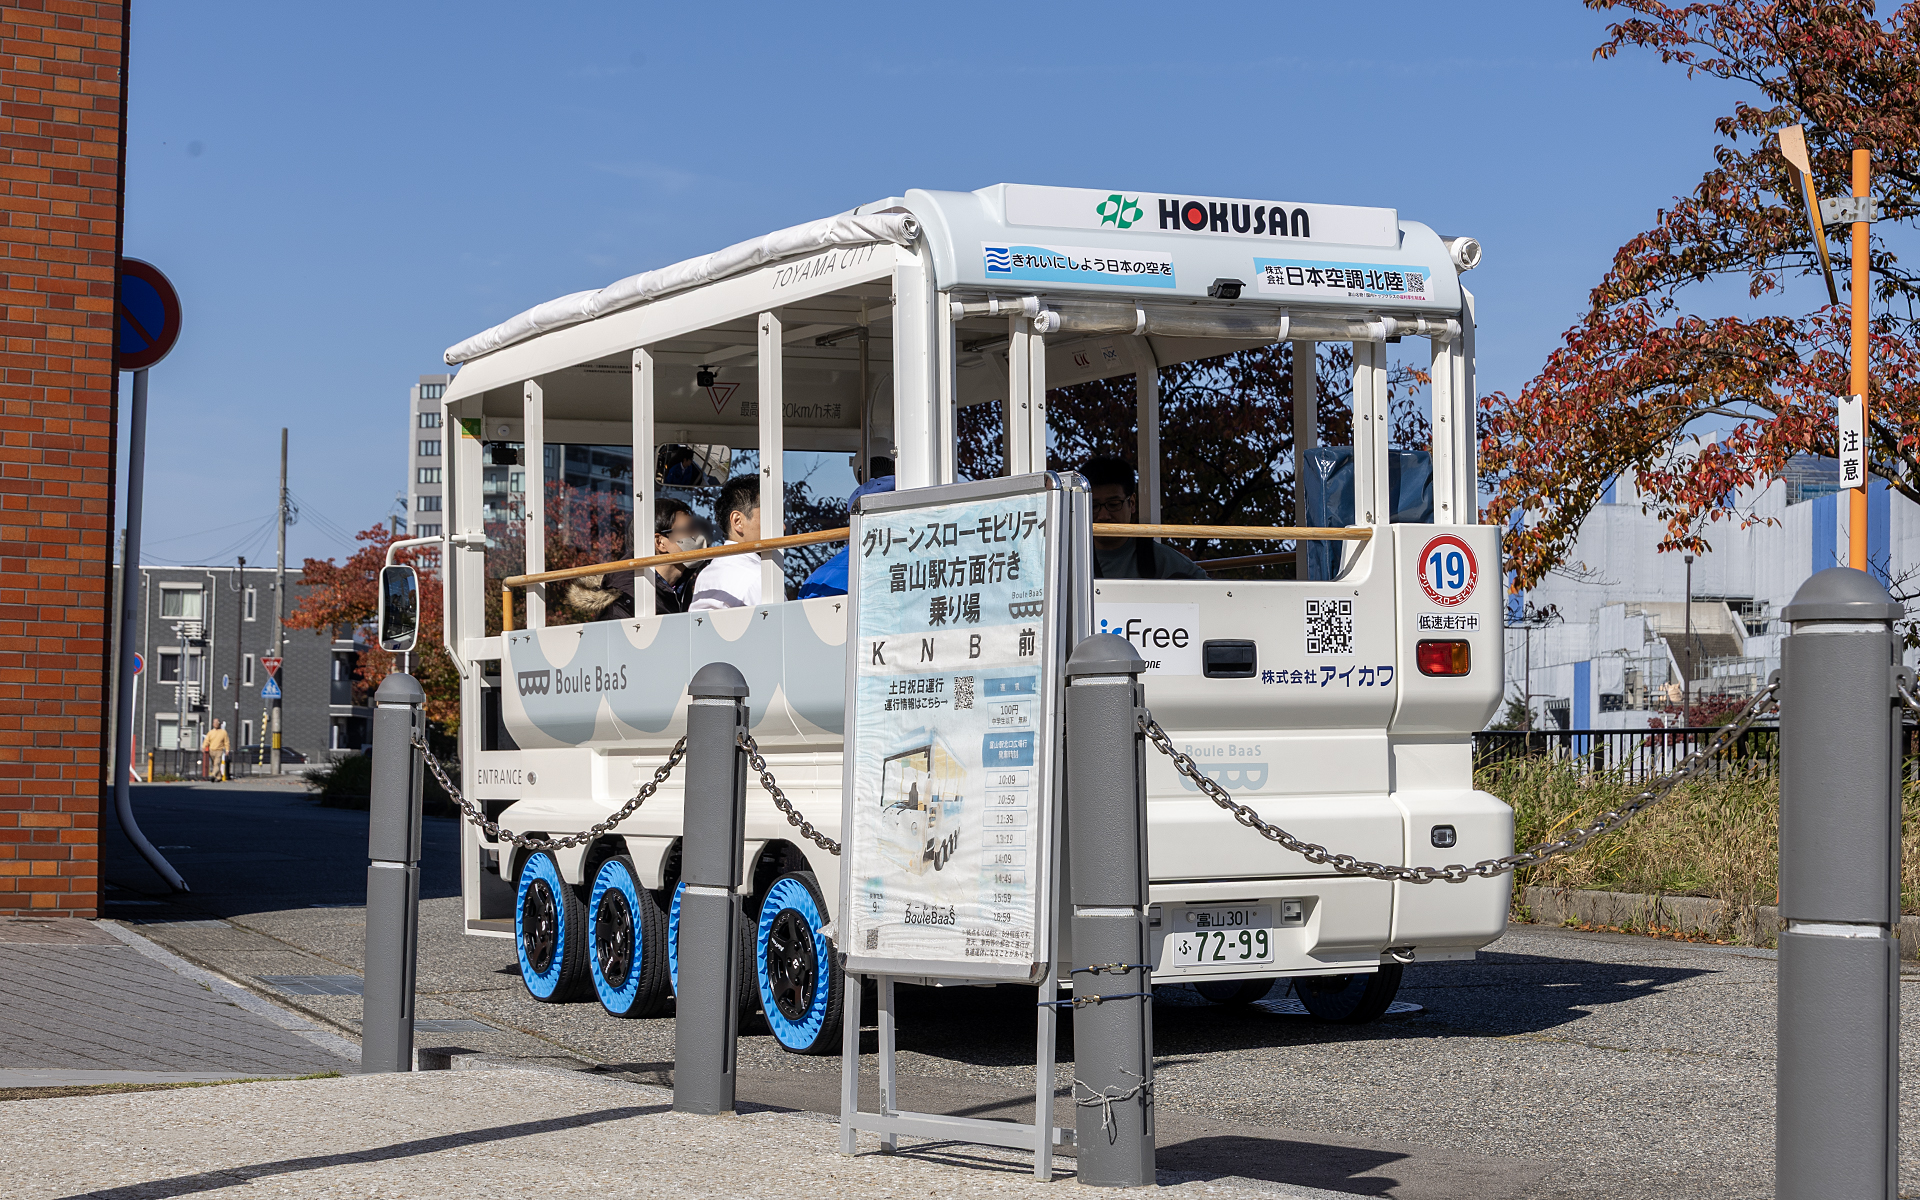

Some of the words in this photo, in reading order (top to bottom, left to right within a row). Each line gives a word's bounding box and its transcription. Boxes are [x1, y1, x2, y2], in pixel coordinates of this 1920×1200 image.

[1158, 199, 1311, 238] HOKUSAN
[772, 253, 837, 289] TOYAMA
[840, 241, 880, 270] CITY
[1012, 254, 1173, 276] きれいにしよう日本の空を
[1264, 266, 1284, 275] 株式
[1266, 275, 1285, 285] 会社
[1286, 267, 1405, 292] 日本空調北陸
[1842, 430, 1859, 481] 注意
[862, 511, 1046, 558] グリーンスローモビリティ
[889, 551, 1021, 594] 富山駅方面行き
[1429, 551, 1465, 589] 19
[1012, 591, 1028, 599] Boule
[1029, 589, 1043, 598] BaaS
[928, 593, 981, 626] 乗り場
[1419, 615, 1478, 630] 低速走行中
[872, 641, 886, 665] K
[920, 638, 935, 662] N
[969, 634, 982, 659] B
[1019, 627, 1035, 657] 前
[556, 667, 591, 694] Boule
[595, 664, 627, 692] BaaS
[888, 678, 945, 695] 土日祝日運行
[1261, 664, 1394, 687] 株式会社アイカワ
[1000, 704, 1019, 716] 100円
[1185, 744, 1224, 757] Boule
[1228, 744, 1262, 756] BaaS
[478, 769, 522, 785] ENTRANCE
[998, 775, 1016, 785] 10:09
[997, 795, 1016, 805] 10:59
[994, 854, 1012, 863] 14:09
[904, 911, 956, 925] BouleBaaS
[1178, 939, 1192, 956] ふ
[1195, 929, 1269, 962] 72-99
